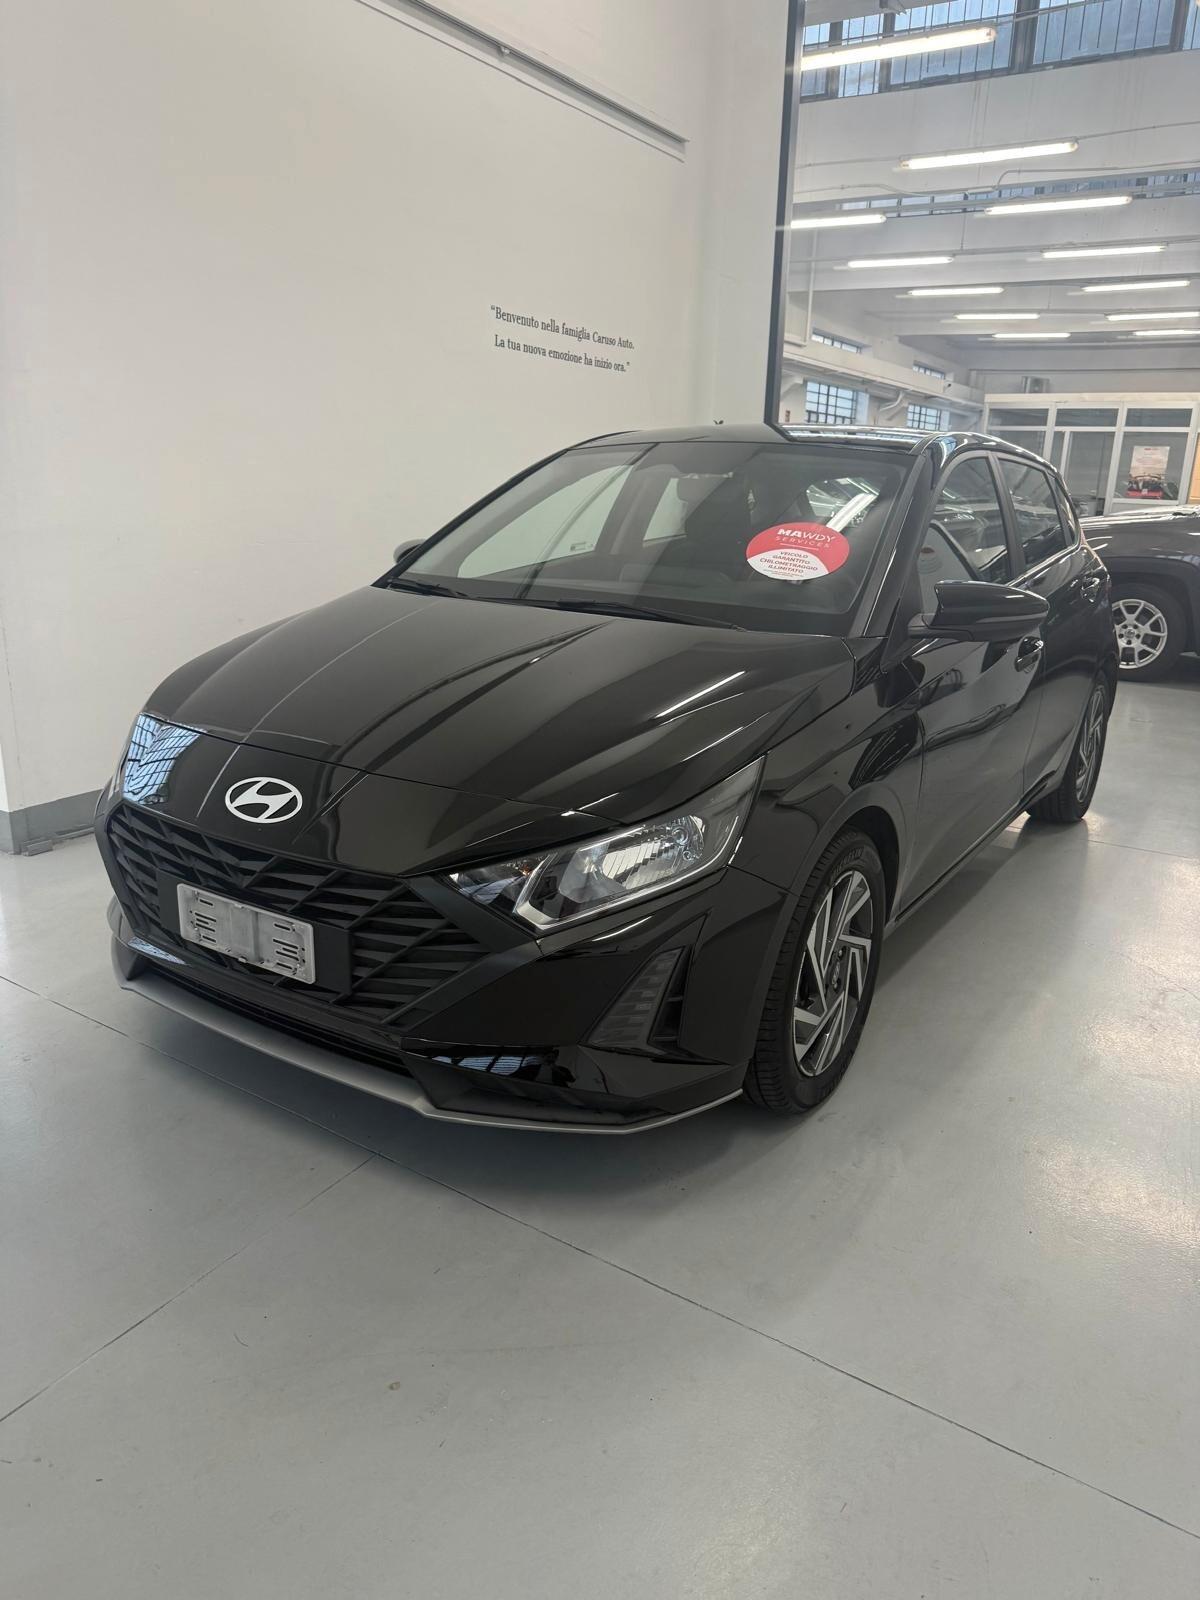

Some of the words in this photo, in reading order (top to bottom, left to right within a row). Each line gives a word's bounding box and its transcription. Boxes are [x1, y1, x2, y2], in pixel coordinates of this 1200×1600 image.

[541, 318, 560, 334] nella
[561, 322, 591, 342] famiglia
[592, 331, 617, 347] Caruso
[617, 337, 635, 350] Auto.
[494, 334, 505, 348] La
[507, 338, 521, 351] tua
[523, 343, 546, 357] nuova
[548, 350, 583, 364] emozione
[584, 353, 593, 366] ha
[594, 356, 613, 370] inizio
[775, 536, 830, 548] SERVICES
[777, 528, 836, 543] MAWDY
[759, 558, 818, 571] CHILOMETRAGGIO
[772, 555, 811, 565] GARANTITO
[767, 565, 804, 574] ILLIMITATO
